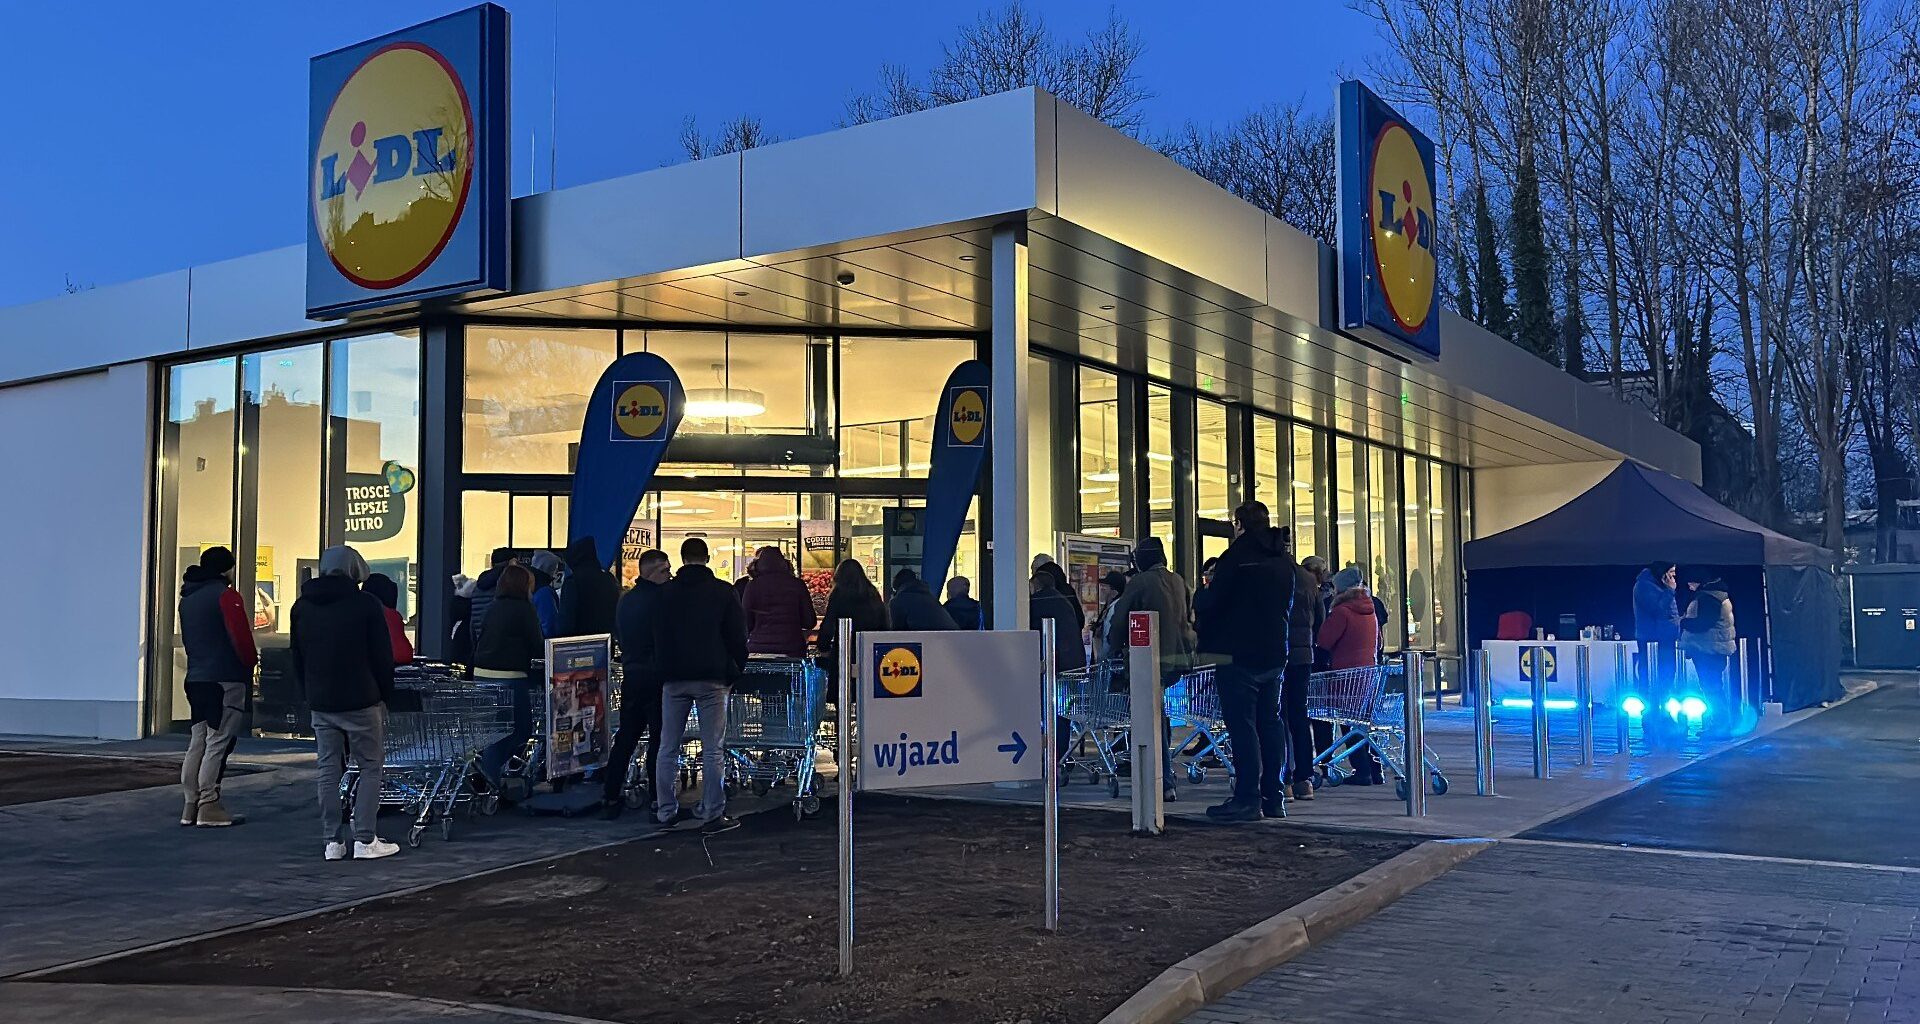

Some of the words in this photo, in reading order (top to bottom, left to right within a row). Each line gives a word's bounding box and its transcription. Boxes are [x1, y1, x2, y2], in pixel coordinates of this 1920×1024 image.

[345, 485, 391, 500] TROSCE
[348, 501, 389, 516] LEPSZE
[345, 517, 384, 532] JUTRO
[622, 529, 651, 546] ECZEK
[873, 731, 960, 776] wjazd
